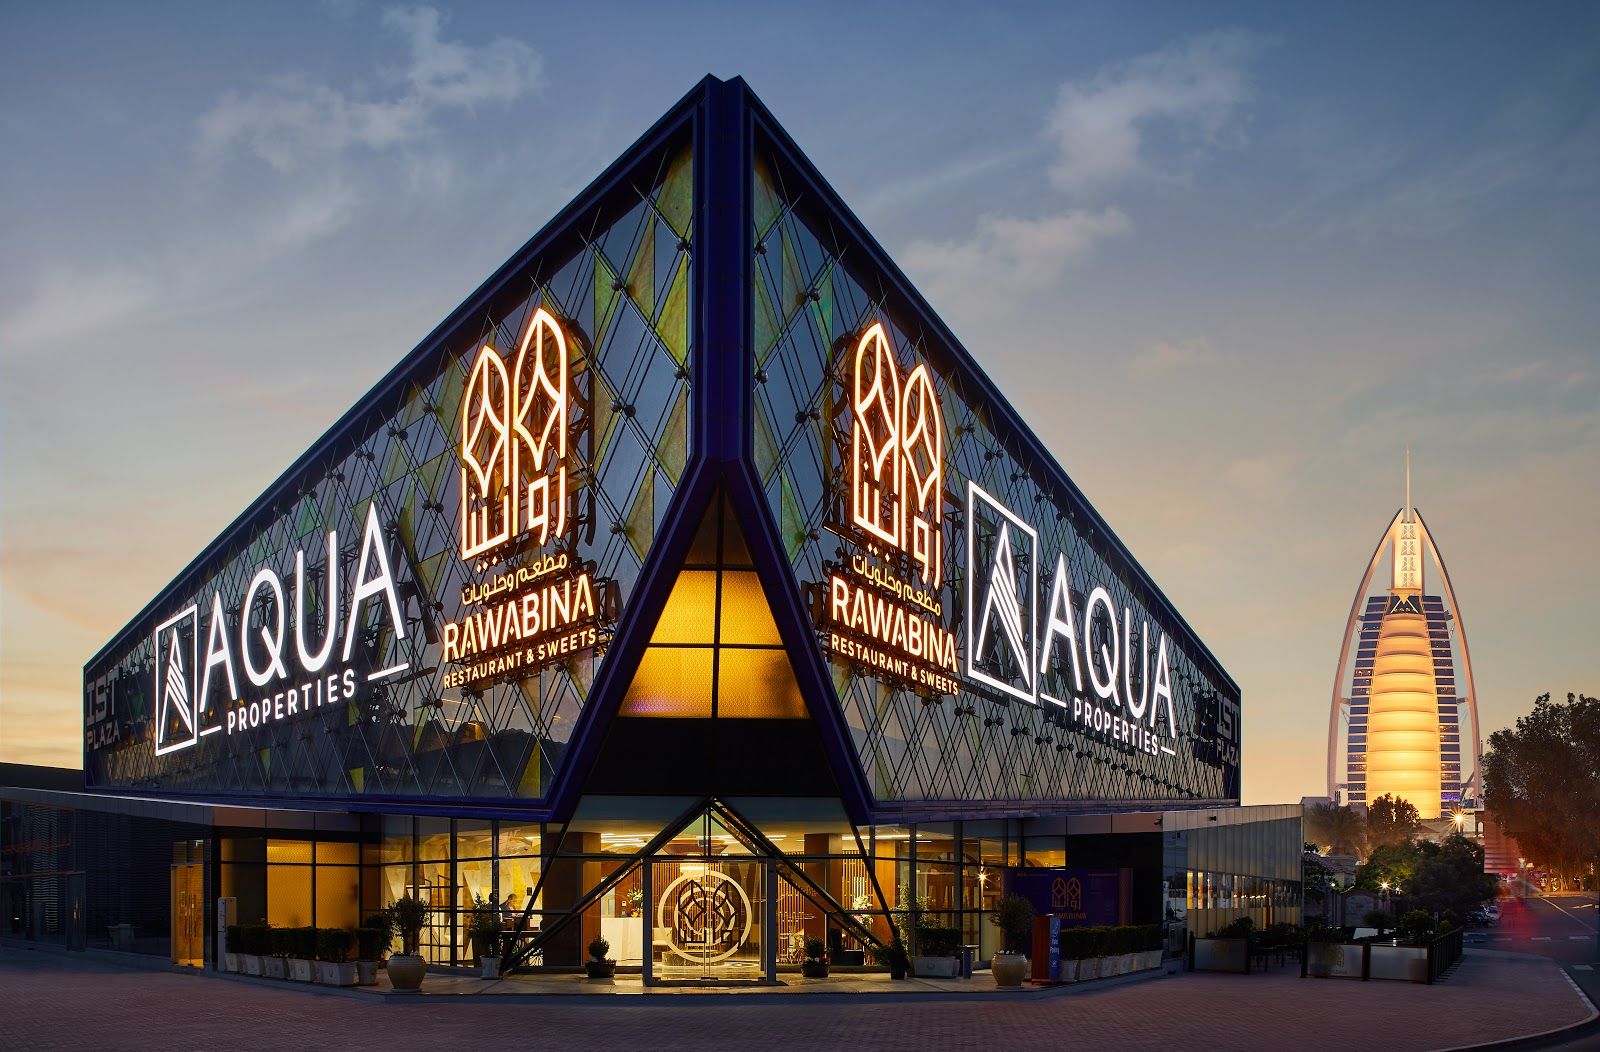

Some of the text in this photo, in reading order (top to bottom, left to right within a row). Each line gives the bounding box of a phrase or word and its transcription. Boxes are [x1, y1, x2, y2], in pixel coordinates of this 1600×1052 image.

[515, 553, 568, 589] مطعم
[903, 584, 941, 616] مطعم
[199, 501, 405, 713] AQUA
[444, 573, 595, 663] RAWABINA
[832, 575, 958, 673] RAWABINA
[443, 628, 597, 689] RESTAURANT & SWEETS
[831, 633, 959, 695] RESTAURANT & SWEETS
[1040, 552, 1176, 739] AQUA
[227, 668, 355, 735] PROPERTIES
[1074, 696, 1158, 756] PROPERTIES
[86, 719, 120, 753] PLAZA
[1216, 737, 1240, 769] PLAZA
